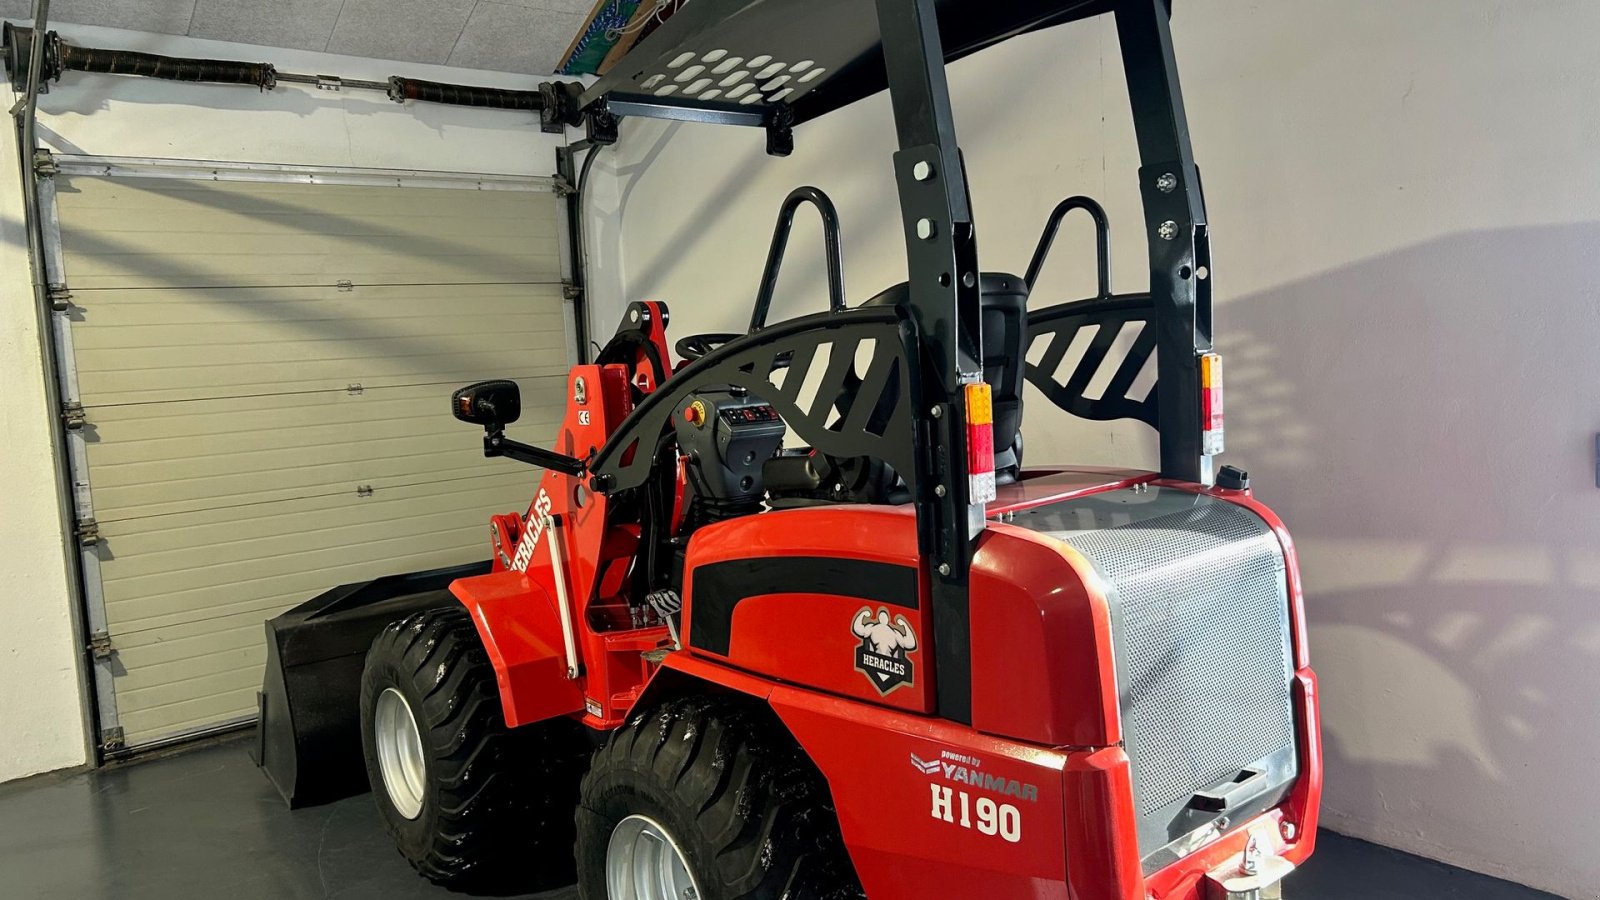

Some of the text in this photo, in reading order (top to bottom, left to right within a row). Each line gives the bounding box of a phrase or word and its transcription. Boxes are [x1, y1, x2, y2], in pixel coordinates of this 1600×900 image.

[579, 411, 589, 424] CE
[863, 653, 905, 676] HERACLES
[941, 750, 981, 768] powered by
[941, 761, 1039, 804] YANMAR
[930, 783, 1021, 843] H190
